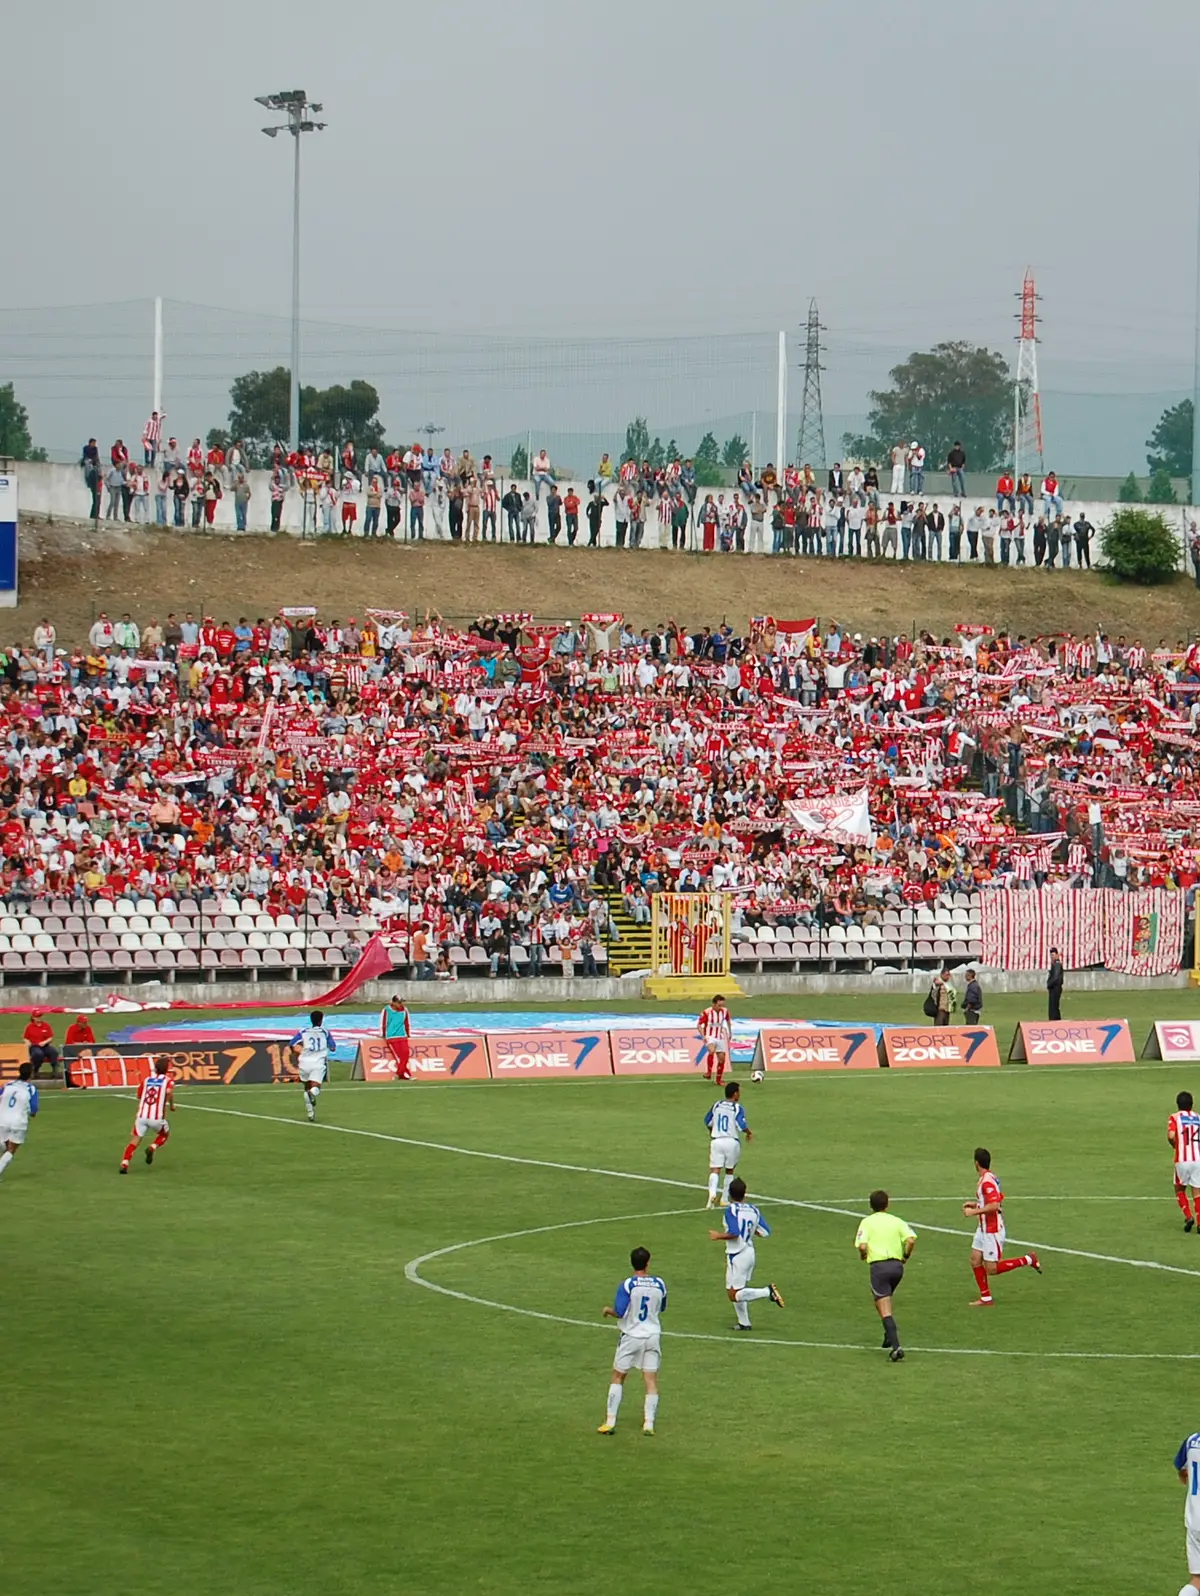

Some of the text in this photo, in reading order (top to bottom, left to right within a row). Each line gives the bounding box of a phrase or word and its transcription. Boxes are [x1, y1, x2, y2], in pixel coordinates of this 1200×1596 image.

[769, 1035, 835, 1049] SPORT
[891, 1034, 955, 1047] SPORT
[1029, 1028, 1091, 1041] SPORT
[309, 1037, 321, 1051] 31
[496, 1040, 565, 1055] SPORT
[619, 1037, 687, 1052] SPORT
[1031, 1040, 1096, 1053] ZONE
[498, 1053, 570, 1068] ZONE
[620, 1049, 690, 1064] ZONE
[770, 1048, 840, 1062] ZONE
[893, 1046, 961, 1061] ZONE
[8, 1090, 17, 1108] 6
[145, 1087, 158, 1106] 8
[717, 1113, 729, 1133] 10
[1181, 1126, 1200, 1146] 14
[638, 1295, 650, 1321] 5
